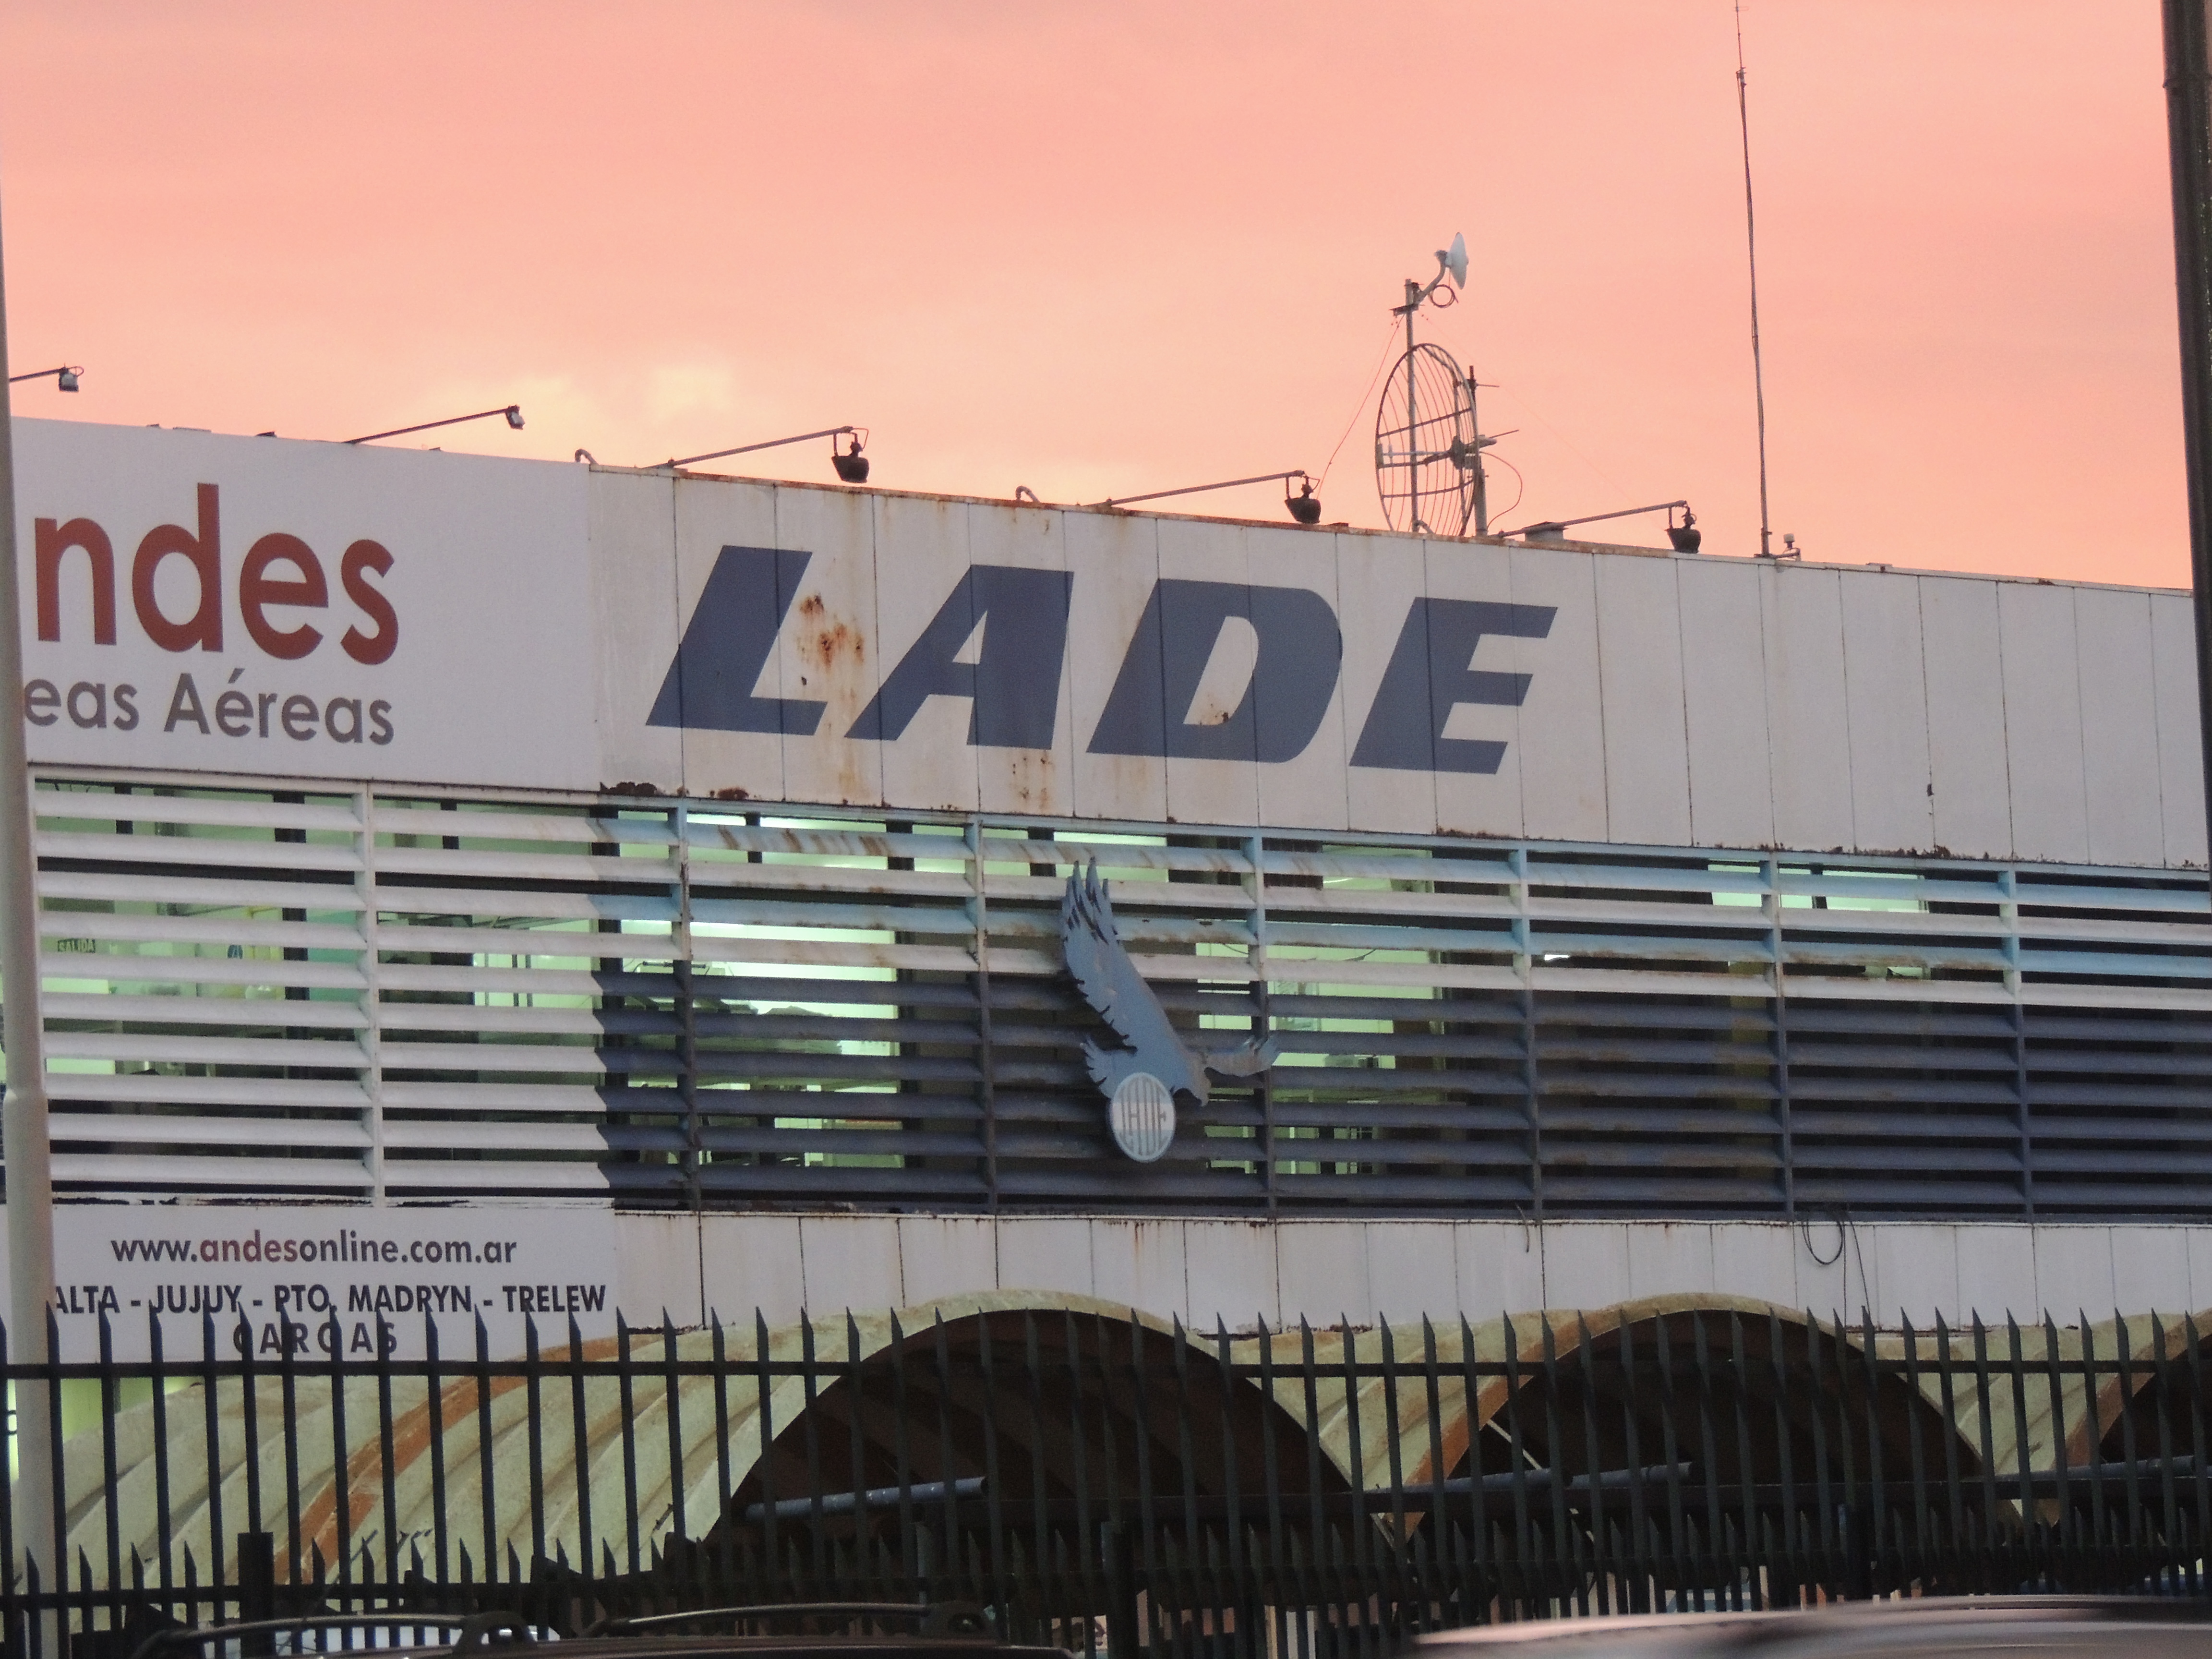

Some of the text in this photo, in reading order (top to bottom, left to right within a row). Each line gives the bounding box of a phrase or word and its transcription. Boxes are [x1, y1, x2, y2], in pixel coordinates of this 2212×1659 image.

[646, 545, 1558, 774] LADE
[164, 668, 395, 745] Aéreas
[111, 1229, 517, 1263] www.andesonline.com.ar
[150, 1285, 242, 1313] JUJUY
[349, 1284, 472, 1312] MADRYN
[503, 1285, 605, 1312] TRELEW
